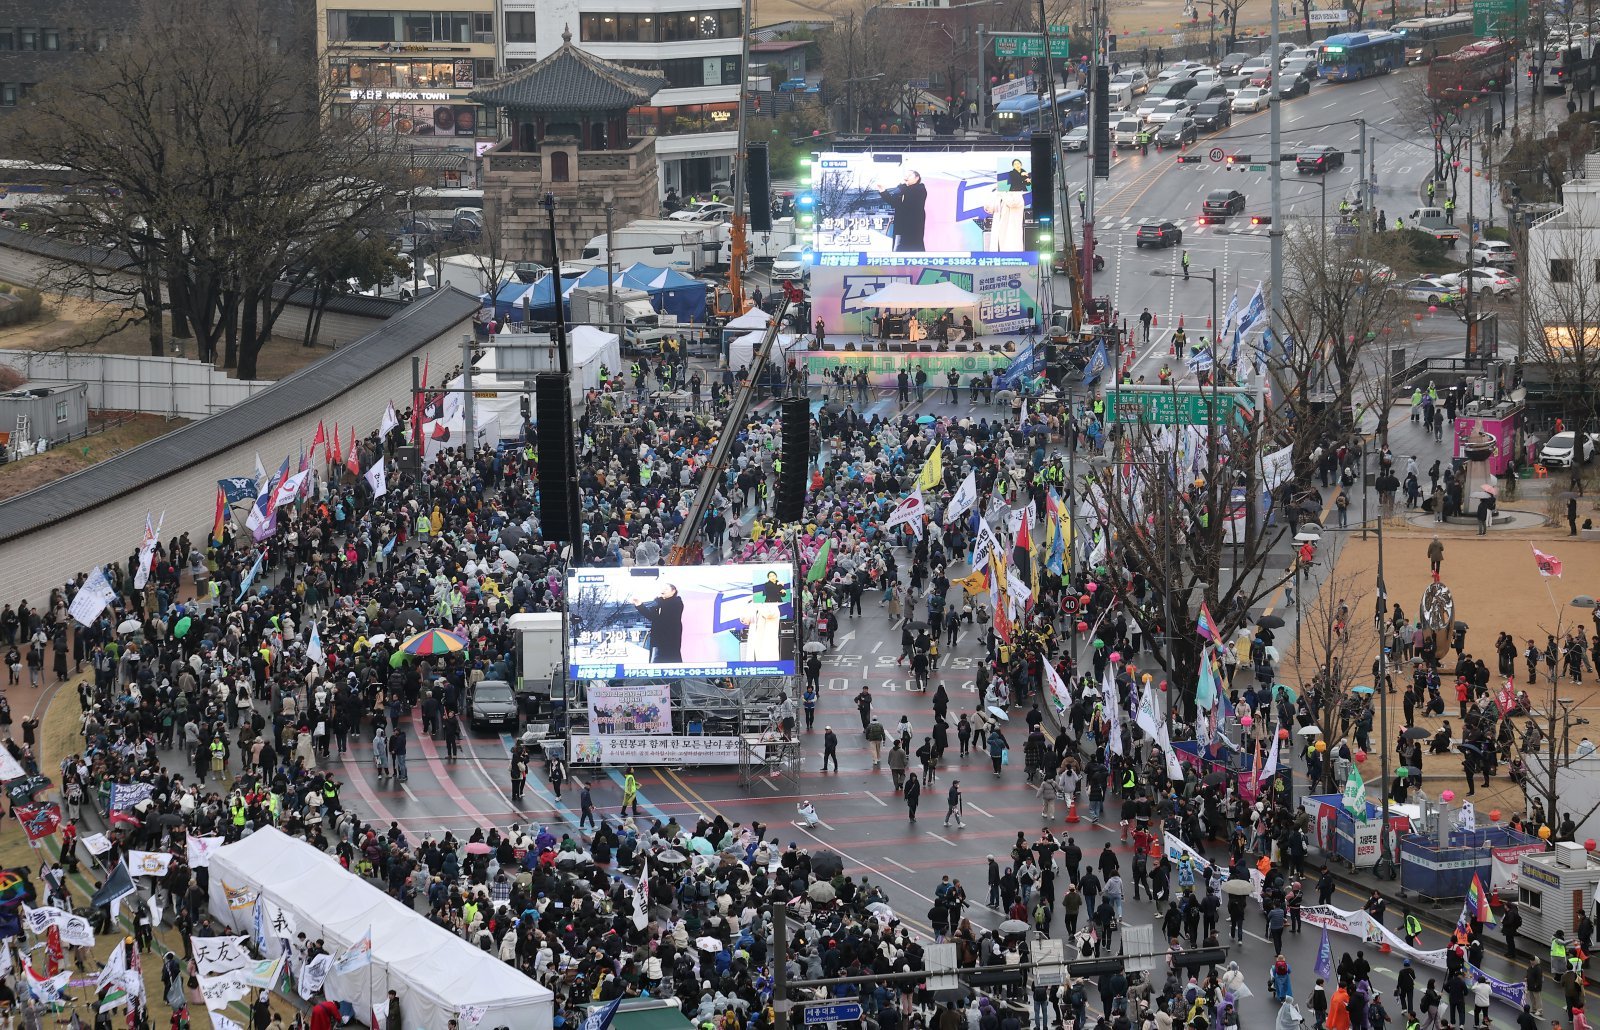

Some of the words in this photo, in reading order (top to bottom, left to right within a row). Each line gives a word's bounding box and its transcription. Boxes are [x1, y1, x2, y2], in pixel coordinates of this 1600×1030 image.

[1212, 151, 1221, 159] 40
[824, 218, 844, 230] 함께
[848, 217, 870, 230] 가야
[873, 217, 884, 230] 할
[824, 234, 835, 245] 그
[839, 234, 871, 246] 곳으로
[866, 257, 905, 266] 카카오뱅크
[981, 302, 1021, 320] 대행진
[1065, 600, 1075, 609] 40
[580, 630, 602, 643] 함께
[605, 630, 627, 643] 가야
[630, 630, 641, 642] 할
[581, 647, 592, 659] 그
[596, 647, 628, 660] 곳으로
[624, 669, 662, 677] 카카오뱅크
[609, 738, 646, 749] 응원봉과
[649, 738, 668, 749] 함께
[671, 738, 680, 749] 한
[682, 739, 701, 749] 모든
[703, 738, 722, 749] 날이
[806, 1007, 836, 1017] 세종대로
[806, 1015, 839, 1023] Sejong-daero
